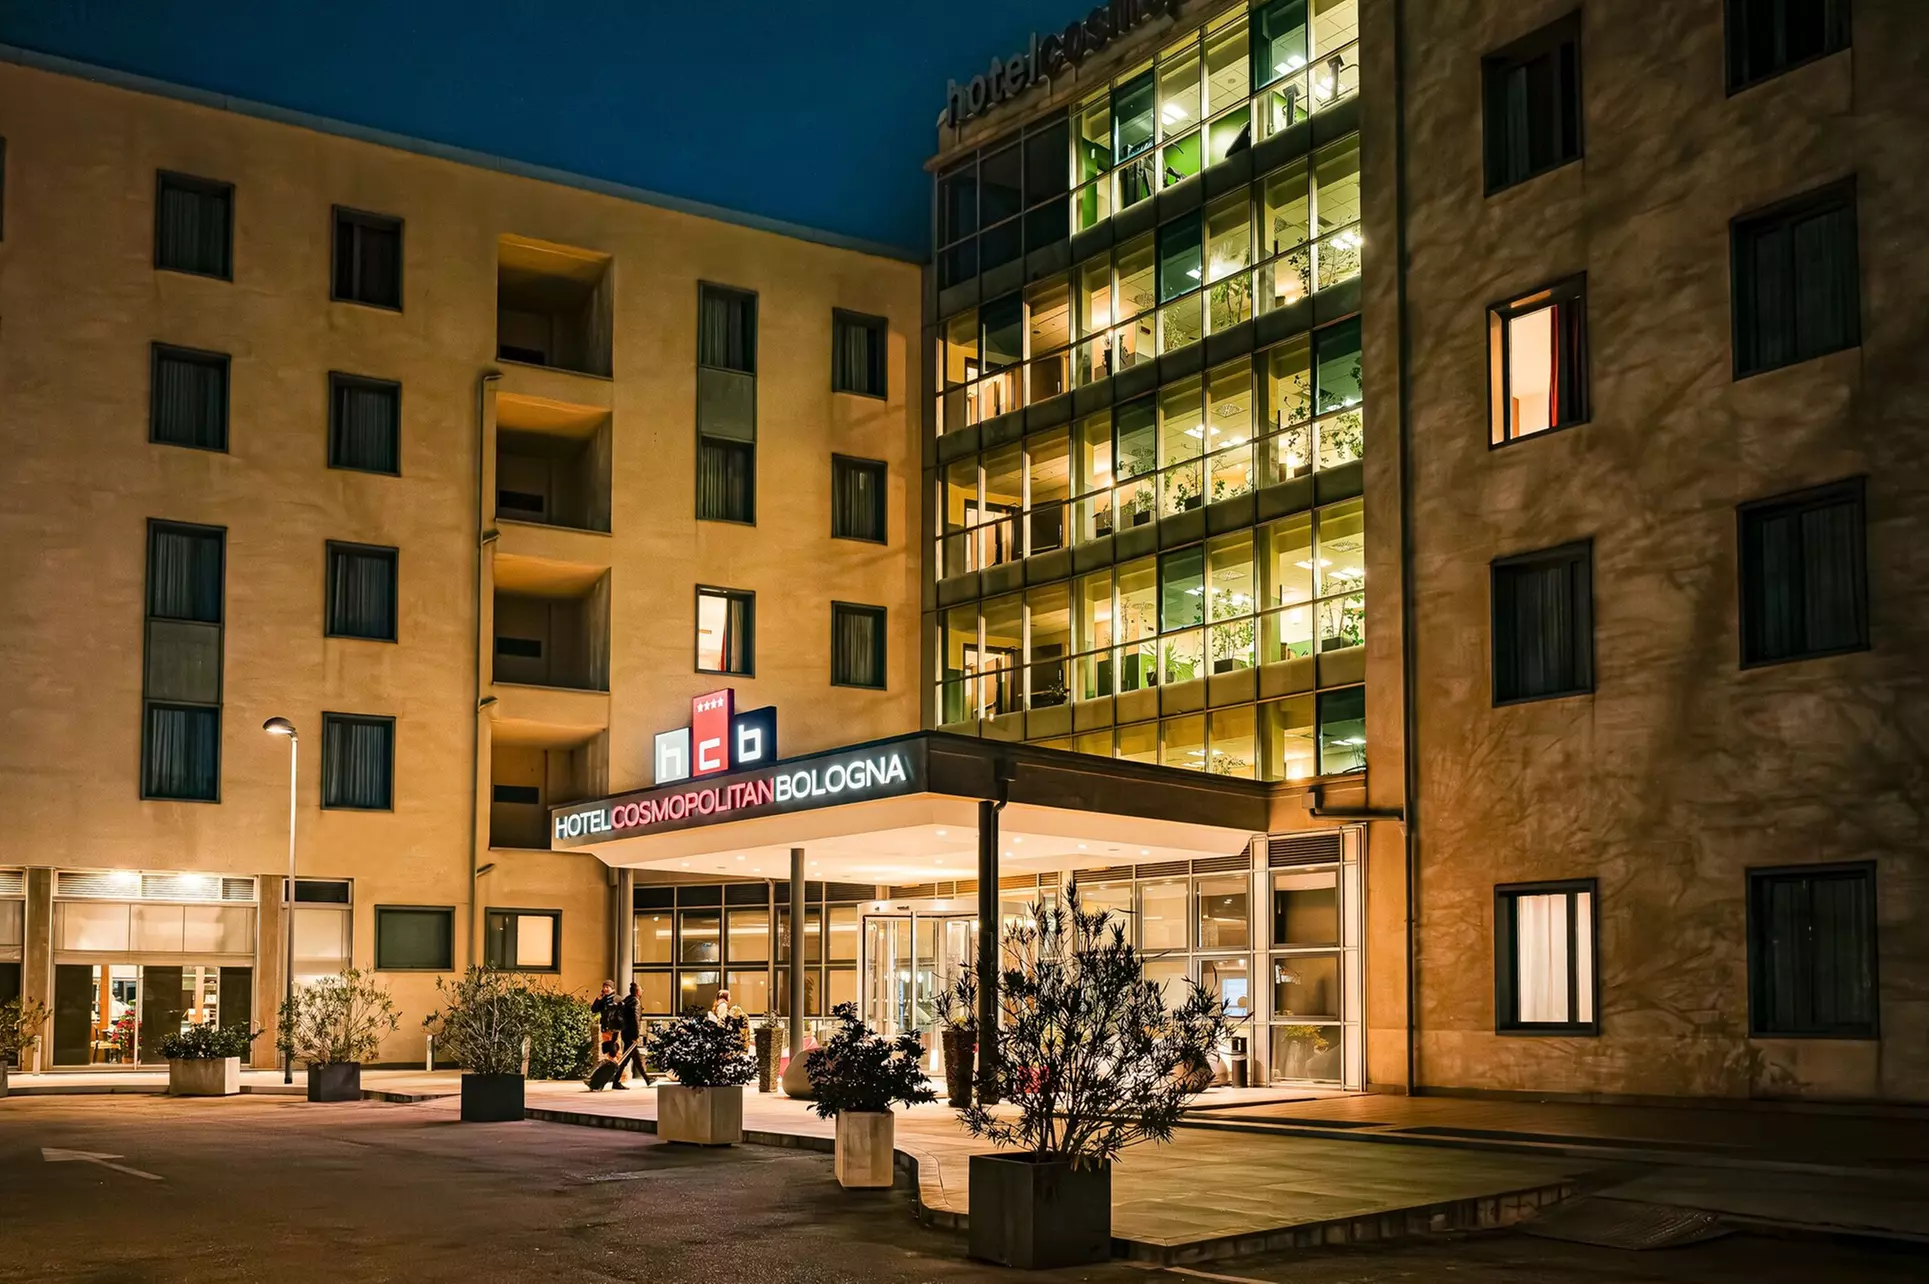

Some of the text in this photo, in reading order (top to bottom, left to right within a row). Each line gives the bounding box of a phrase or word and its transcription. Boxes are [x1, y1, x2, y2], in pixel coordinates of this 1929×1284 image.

[555, 753, 907, 839] HOTEL COSMOPOLITAN BOLOGNA
